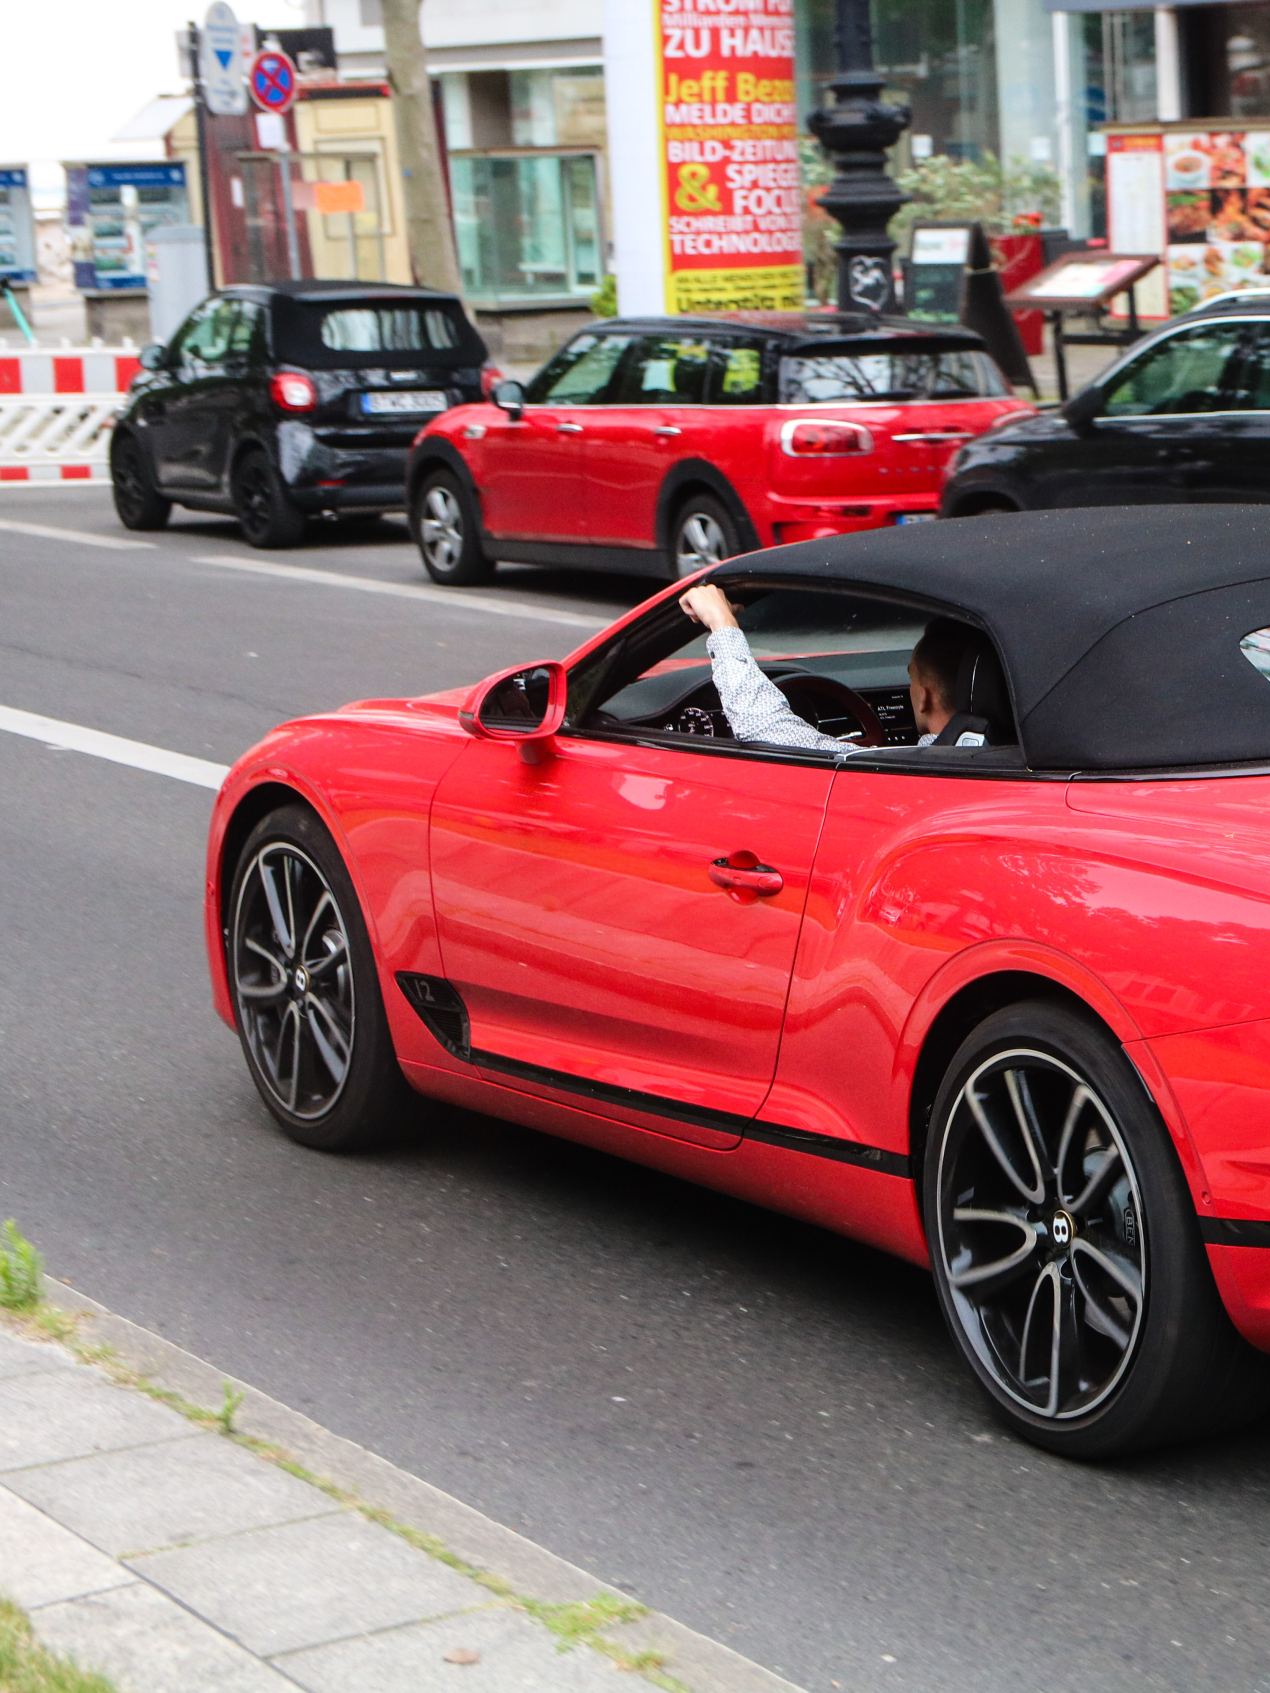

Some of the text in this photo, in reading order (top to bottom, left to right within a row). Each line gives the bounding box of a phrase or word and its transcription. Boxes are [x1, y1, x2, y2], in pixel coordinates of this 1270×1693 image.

[664, 28, 711, 58] ZU
[664, 70, 729, 103] Jeff
[665, 103, 749, 125] MELDE
[675, 163, 723, 212] &
